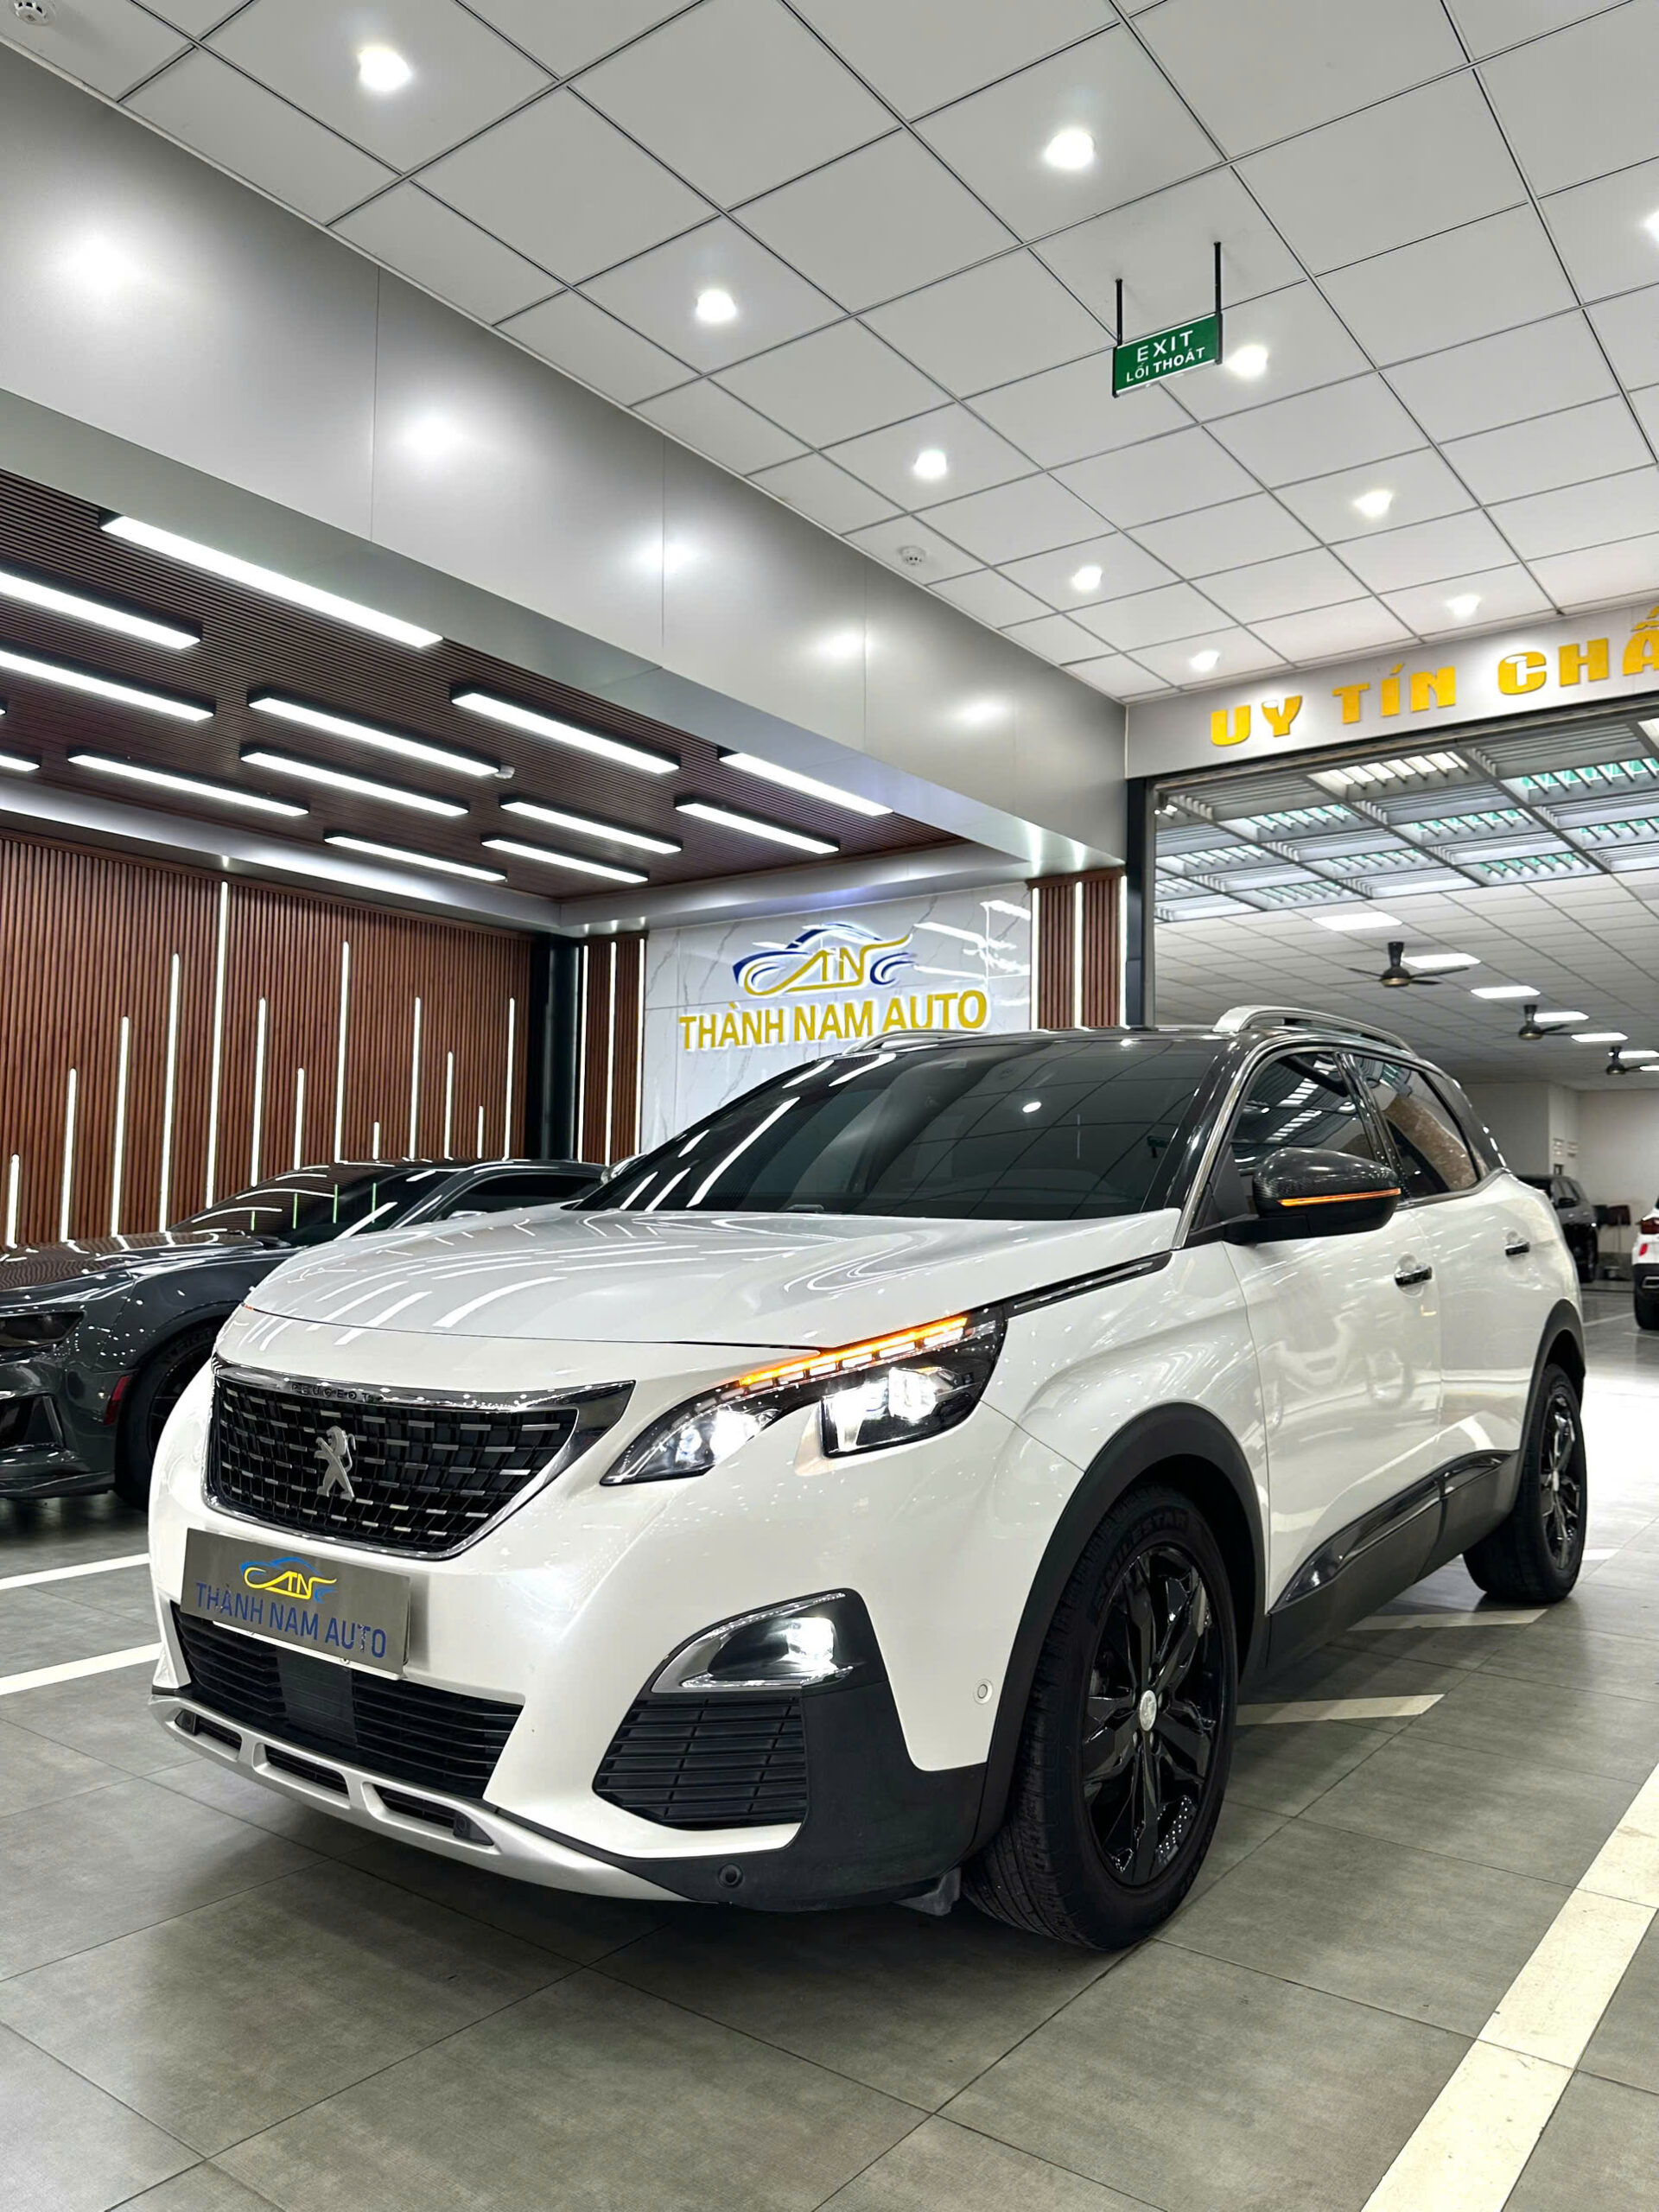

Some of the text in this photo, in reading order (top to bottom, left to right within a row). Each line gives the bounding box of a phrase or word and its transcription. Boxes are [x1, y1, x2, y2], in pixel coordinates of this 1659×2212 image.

[1126, 346, 1205, 382] LỐI THOÁT
[1137, 330, 1193, 362] EXIT
[1211, 695, 1303, 747] UY
[1333, 663, 1457, 725] TÍN
[678, 989, 987, 1051] THÀNH NAM AUTO
[292, 1383, 370, 1402] PEUGEOT
[196, 1582, 386, 1658] THÀNH NAM AUTO
